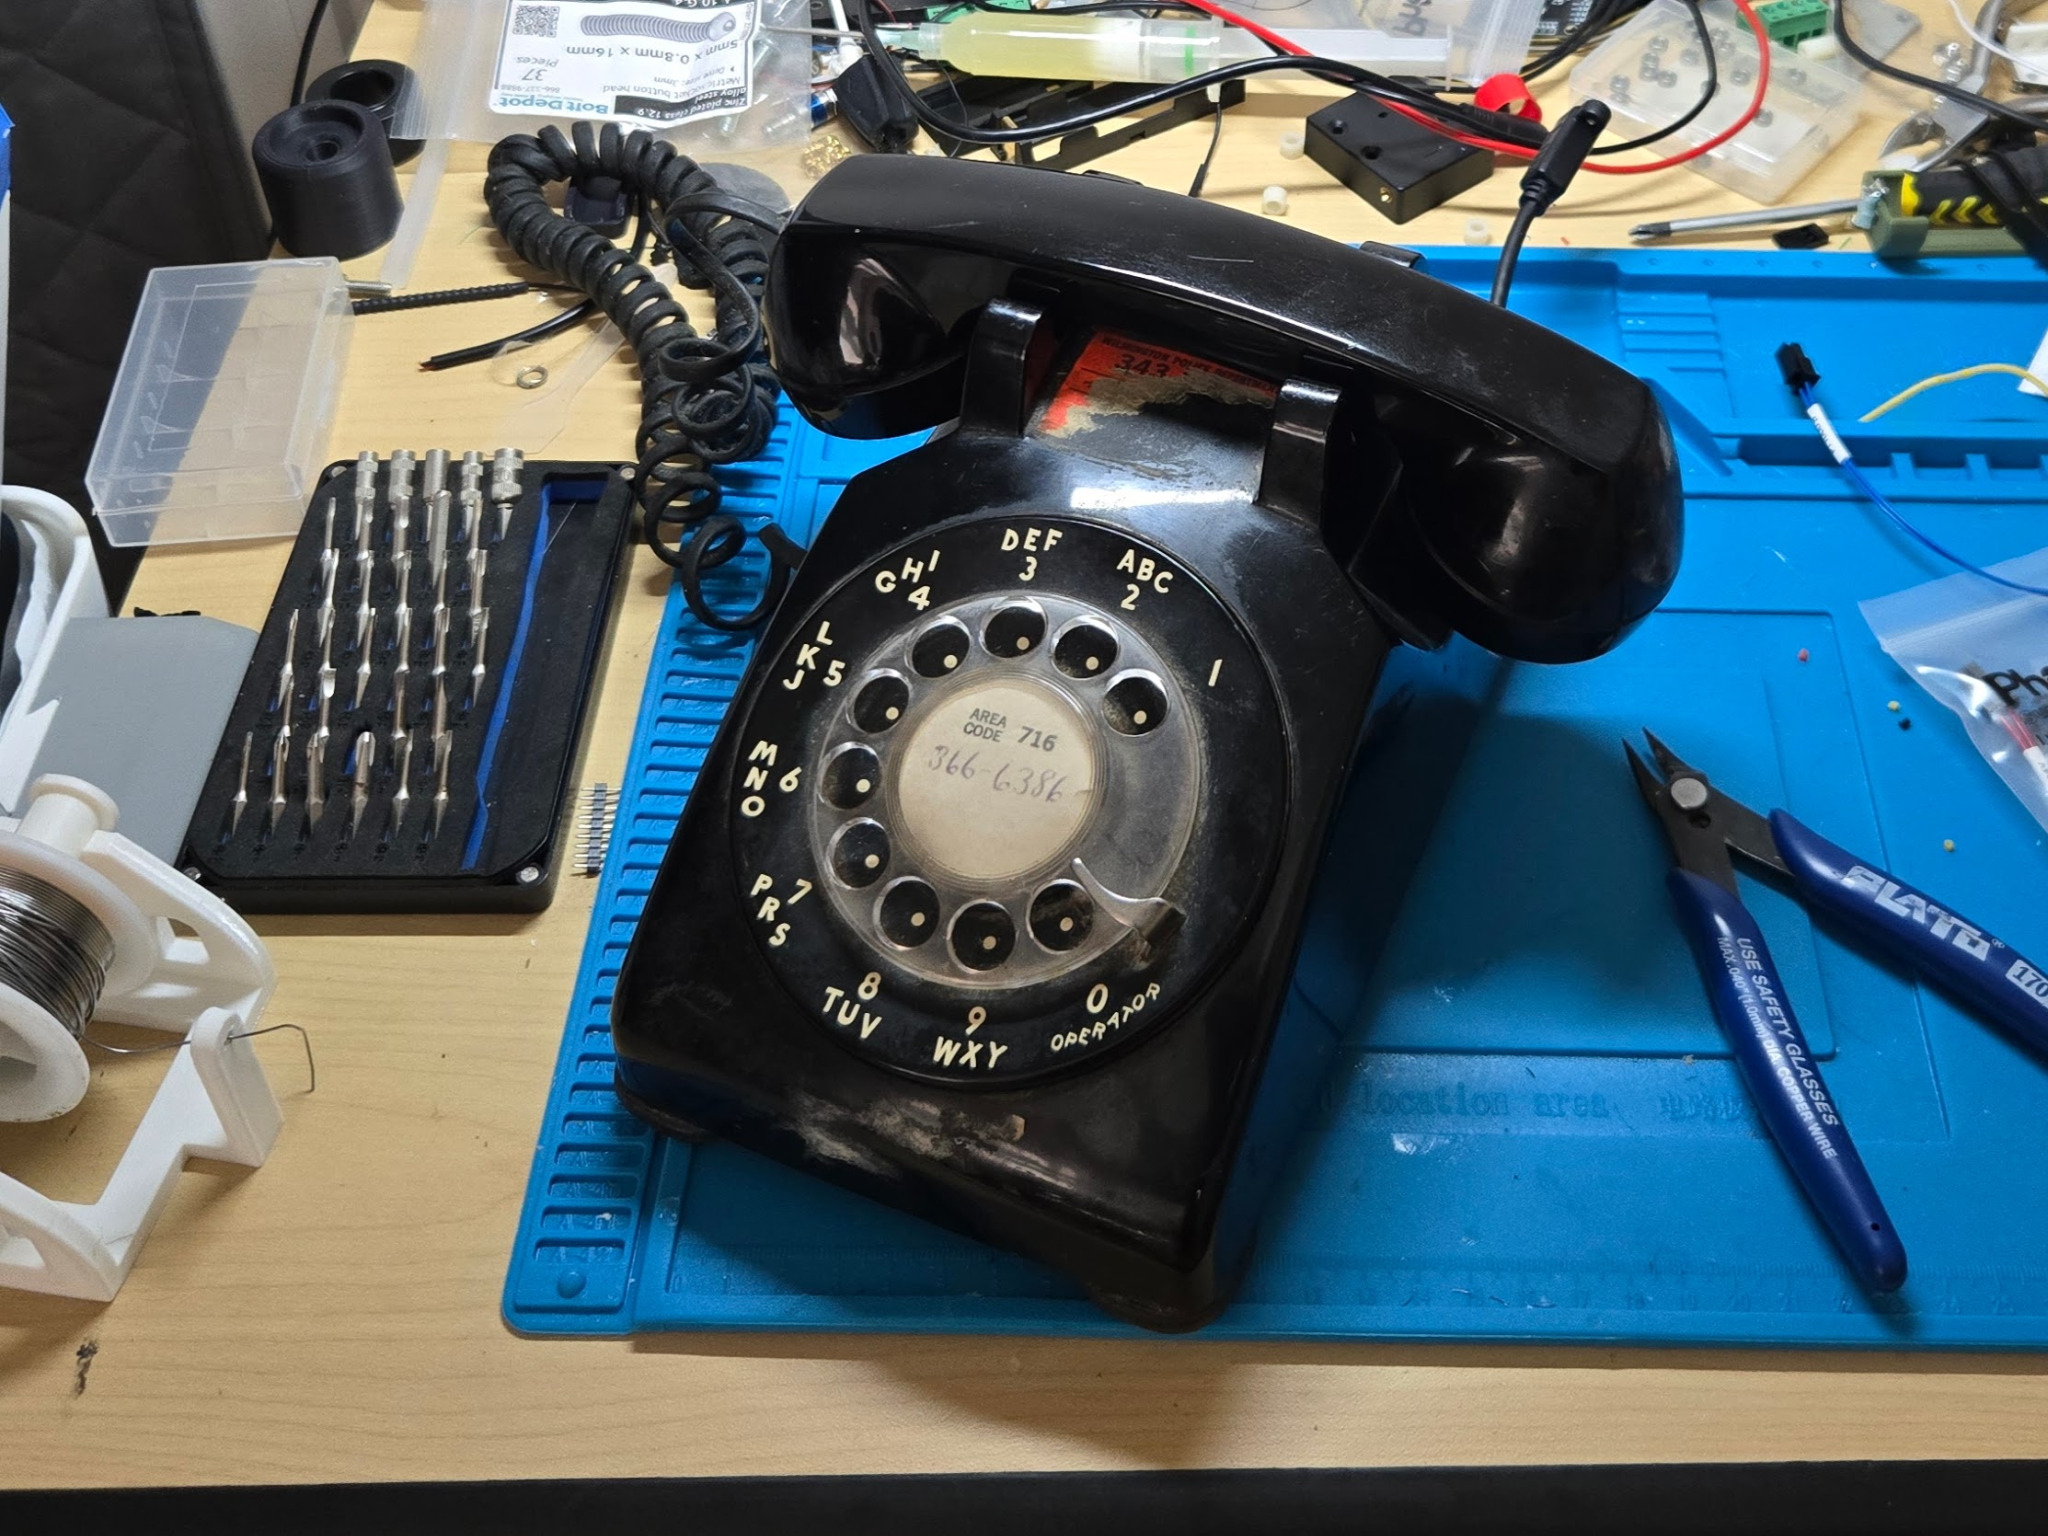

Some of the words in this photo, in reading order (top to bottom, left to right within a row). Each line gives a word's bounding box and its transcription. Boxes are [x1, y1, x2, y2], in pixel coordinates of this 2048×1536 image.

[566, 46, 614, 58] 16mm
[620, 46, 630, 56] x
[634, 47, 690, 65] 0.8mm
[694, 53, 703, 62] x
[705, 40, 738, 57] 5mm
[521, 68, 547, 81] 37
[707, 77, 741, 89] Metric
[602, 84, 631, 95] head
[633, 85, 671, 99] button
[695, 91, 719, 104] steel
[721, 87, 747, 97] alloy
[499, 95, 563, 111] Depot
[566, 102, 609, 115] Bolt
[637, 108, 662, 119] 12.9
[690, 98, 722, 114] plated
[724, 97, 747, 107] Zinc
[1001, 528, 1062, 552] DEF
[875, 549, 940, 593] GHI
[1018, 556, 1037, 581] 3
[1116, 549, 1174, 593] ABC
[907, 586, 931, 611] 4
[1120, 583, 1140, 610] 2
[822, 660, 846, 687] 5
[969, 708, 1007, 728] AREA
[963, 722, 1004, 743] CODE
[1017, 726, 1058, 752] 716
[779, 767, 802, 792] 6
[787, 878, 813, 905] 7
[858, 972, 882, 1000] 8
[1086, 983, 1109, 1014] 0
[822, 986, 882, 1039] TUV
[965, 1006, 987, 1036] 9
[1050, 983, 1161, 1051] OPERATOR
[1736, 937, 1762, 972] USE
[1752, 974, 1795, 1040] SAFETY
[1785, 1043, 1839, 1127] GLASSES
[932, 1036, 1008, 1069] WXY
[1362, 1081, 1510, 1117] location
[1533, 1092, 1611, 1118] area
[1776, 1067, 1814, 1123] COPPER
[1808, 1119, 1837, 1159] WIRE
